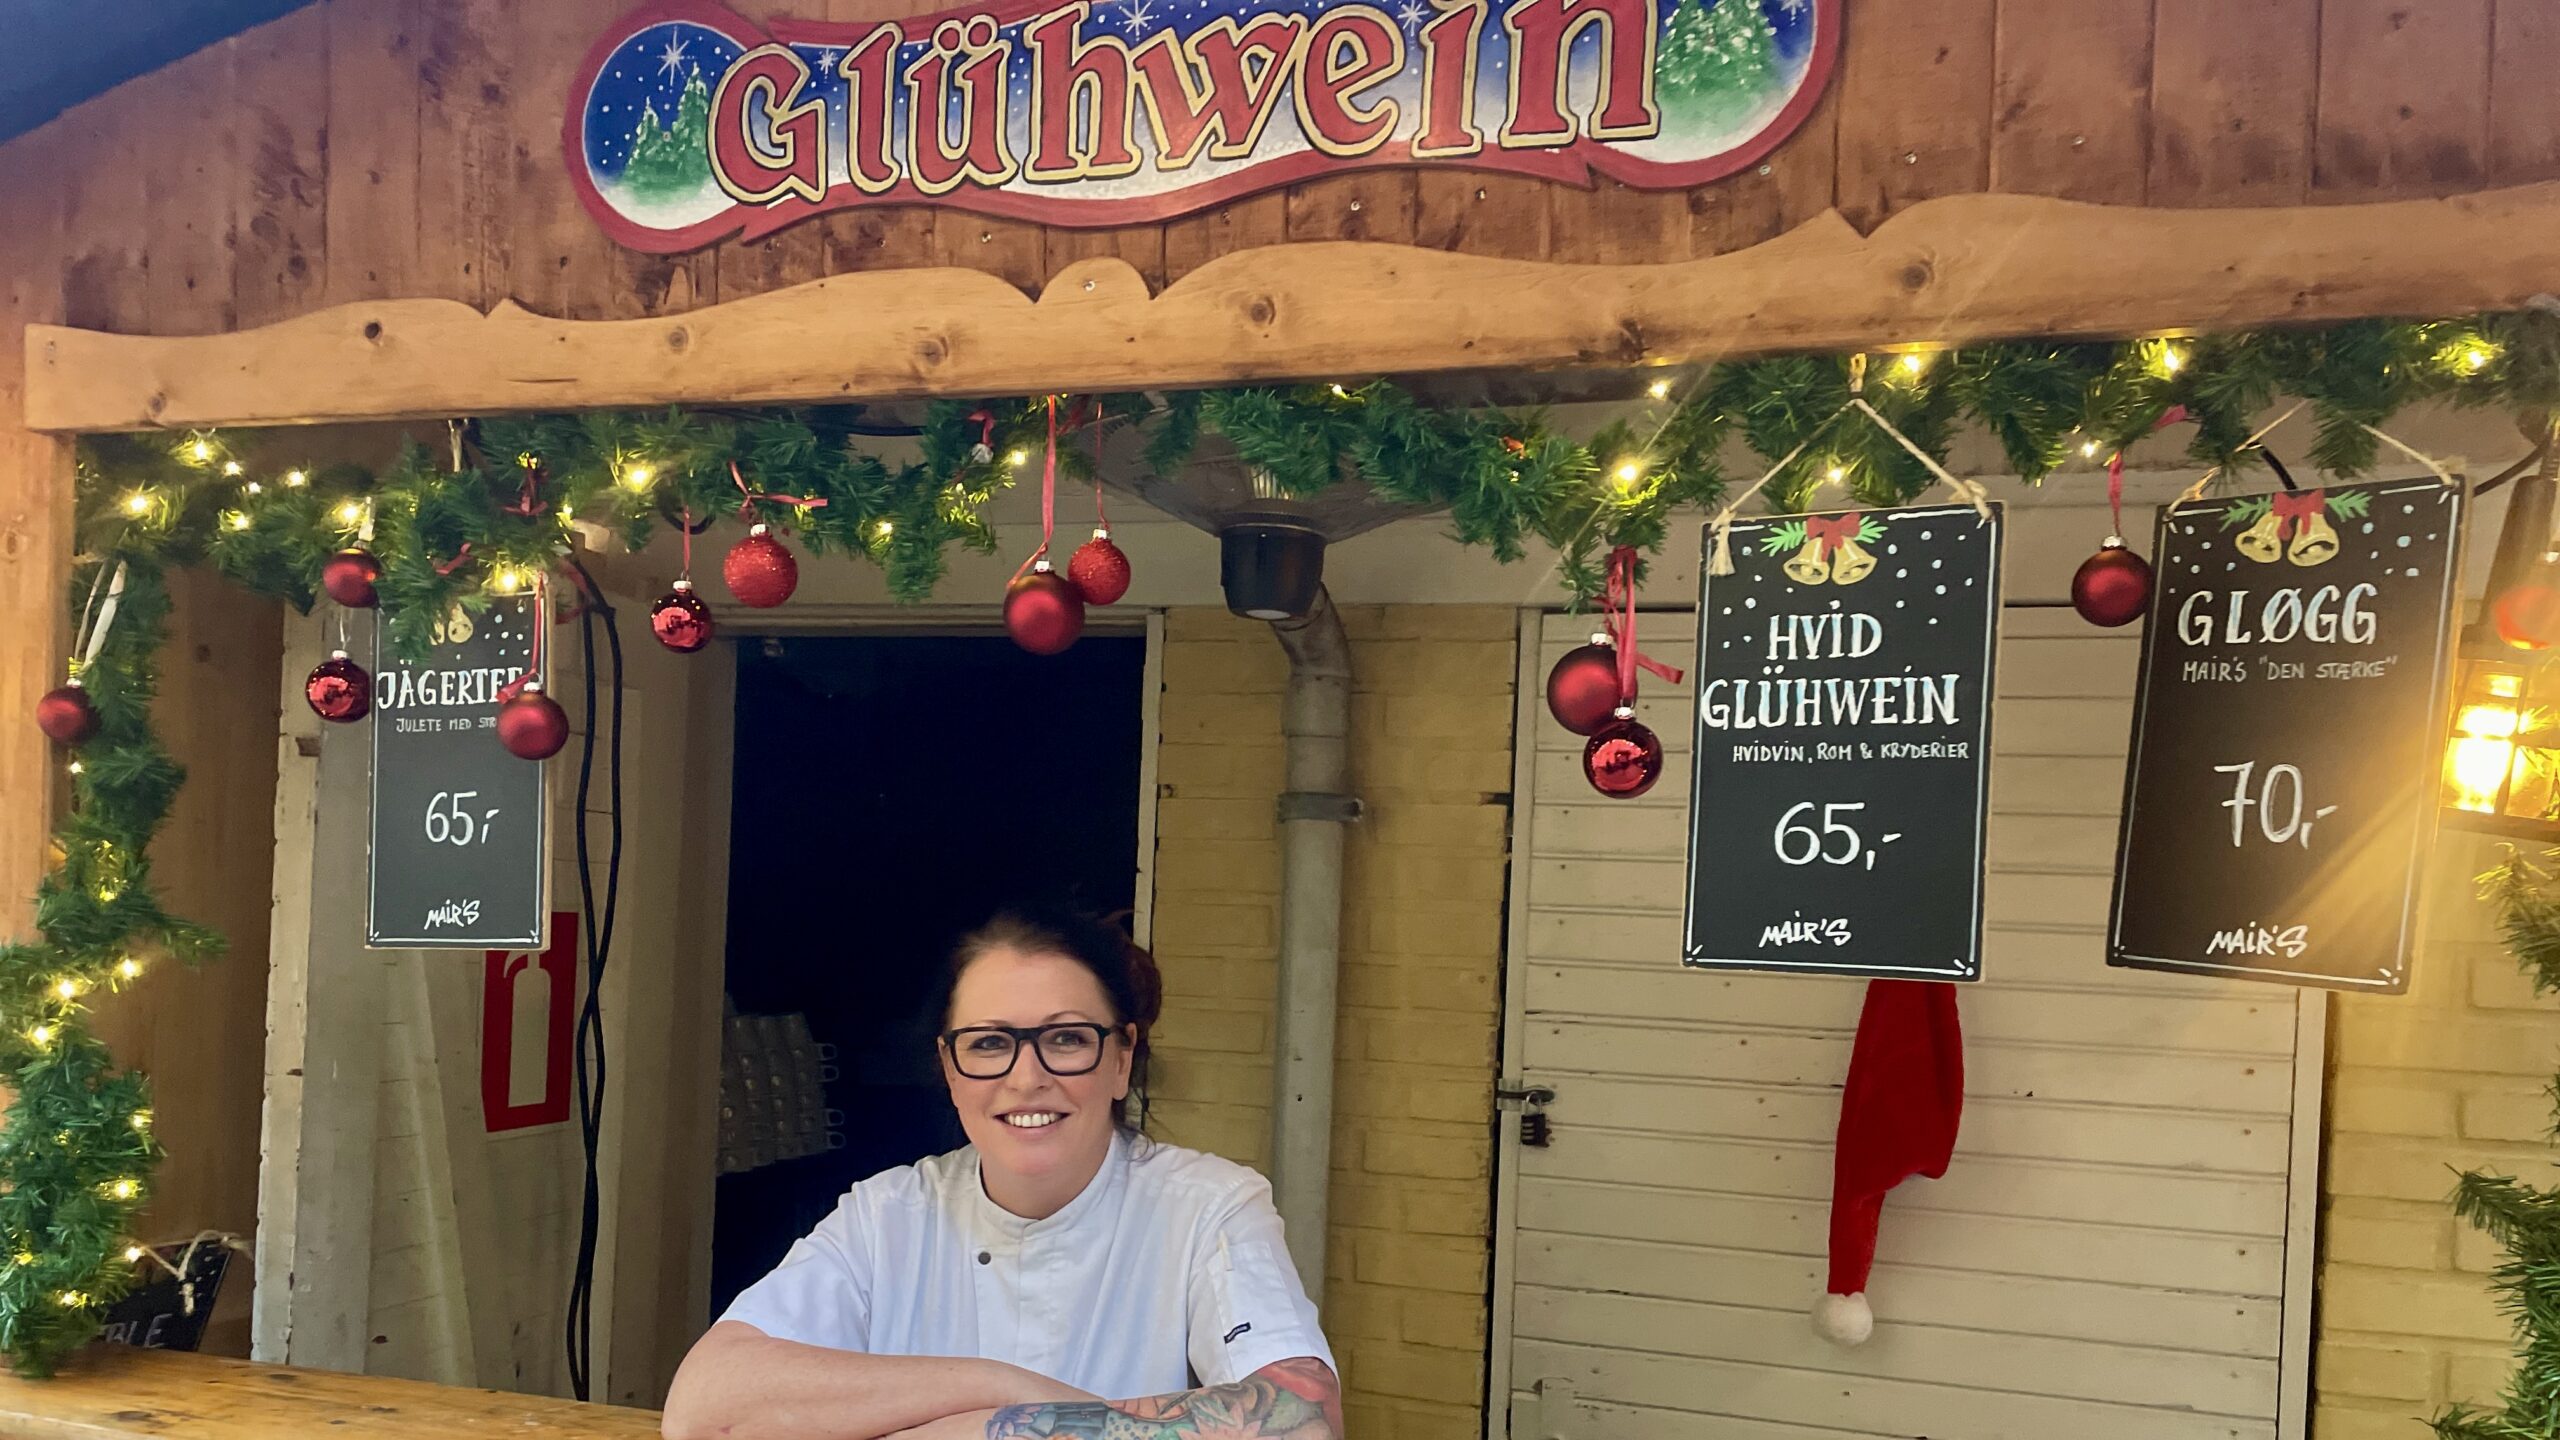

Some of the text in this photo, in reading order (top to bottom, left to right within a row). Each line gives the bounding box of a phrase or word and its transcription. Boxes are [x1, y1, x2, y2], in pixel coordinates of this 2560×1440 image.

[709, 0, 1661, 205] Glühwein
[1766, 600, 1883, 660] HVID
[2177, 582, 2378, 646] GLØGG
[2182, 655, 2247, 683] MAIR'S
[2259, 655, 2304, 680] "DEN
[1701, 665, 1960, 730] GLÜHWEIN
[396, 717, 498, 733] JULETE MED STR
[1733, 735, 1969, 764] HVIDVIN, ROM & KRYDERIER
[2213, 761, 2338, 849] 70,-
[1774, 801, 1902, 871] 65,-
[424, 899, 480, 930] MAIR'S
[1758, 910, 1852, 948] MAIR'S
[2206, 920, 2308, 957] MAIR'S
